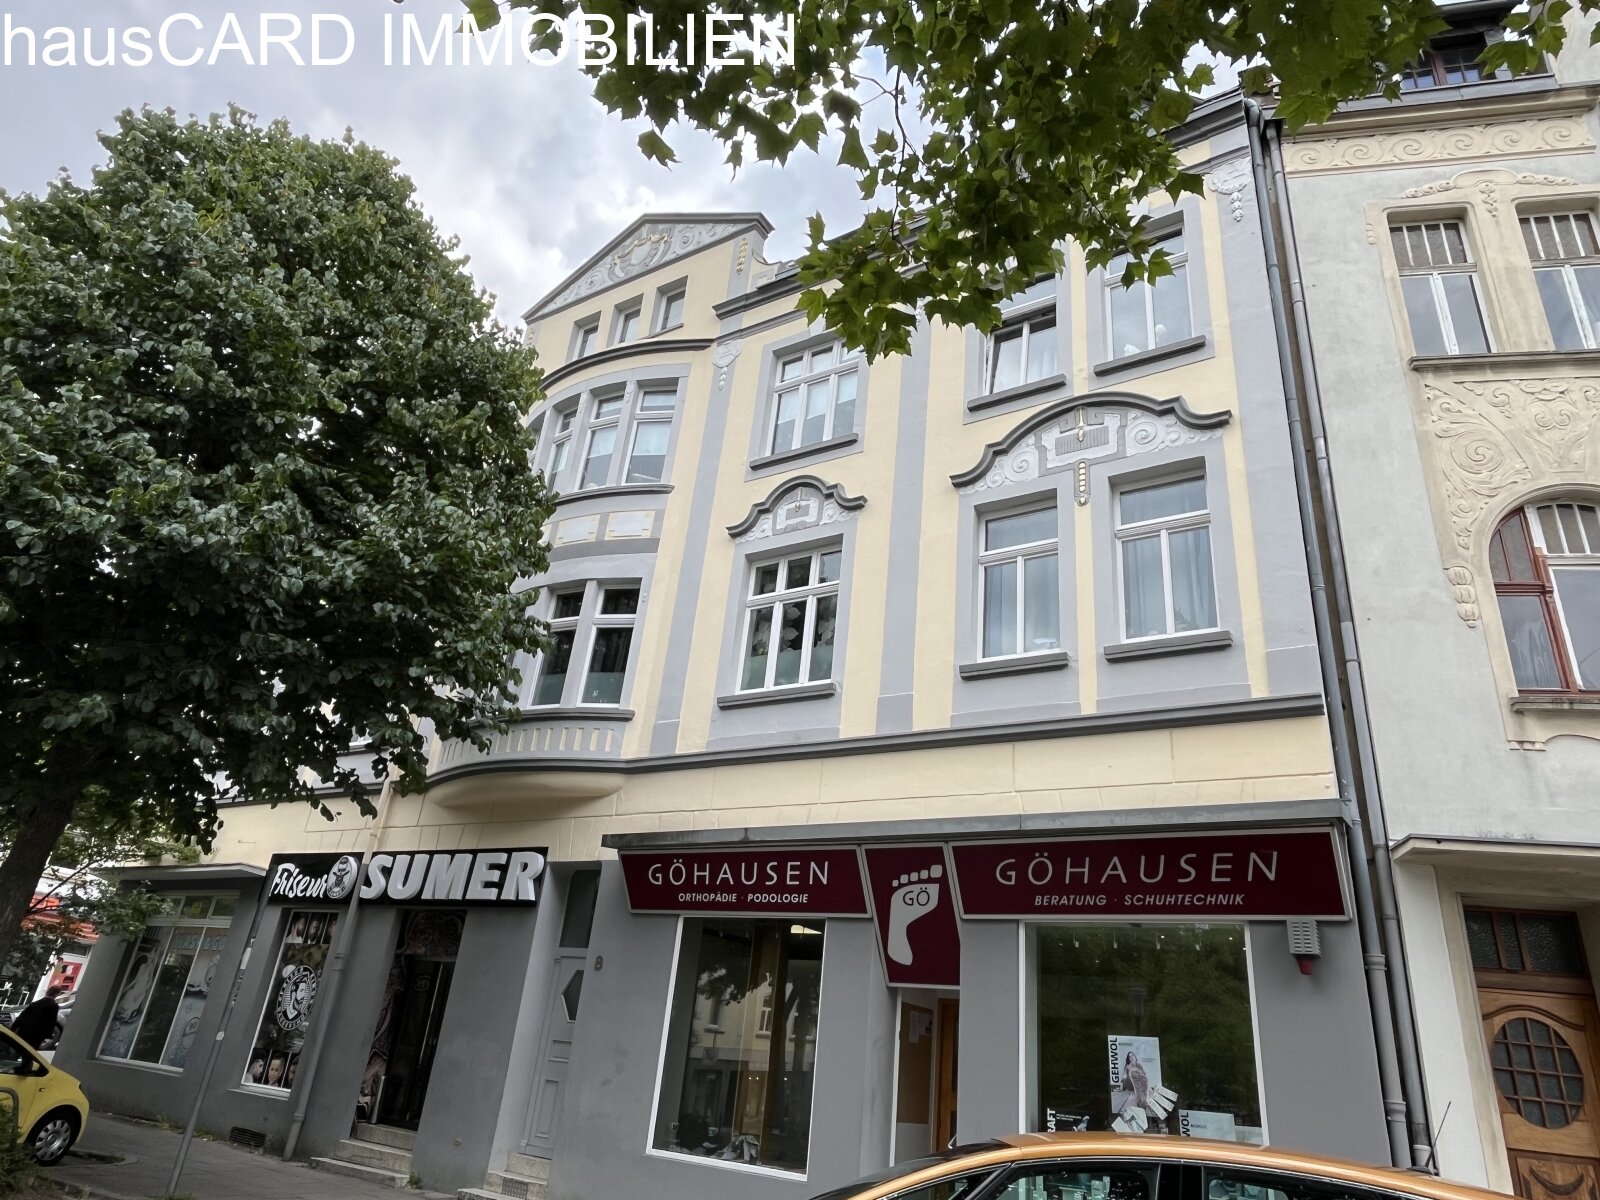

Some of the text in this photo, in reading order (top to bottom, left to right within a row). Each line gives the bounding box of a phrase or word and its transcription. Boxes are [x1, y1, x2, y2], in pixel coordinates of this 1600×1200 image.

[269, 863, 327, 898] Friseur
[360, 851, 546, 902] SUMER
[648, 859, 829, 886] GÖHAUSEN
[995, 851, 1279, 885] GÖHAUSEN
[678, 891, 809, 903] ORTHOPÄDIE PODOLOGIE
[902, 886, 931, 907] GÖ
[1034, 894, 1244, 906] BERATUNG SCHUHTECHNIK
[594, 955, 604, 972] 8
[1109, 1037, 1120, 1083] GEHWOL
